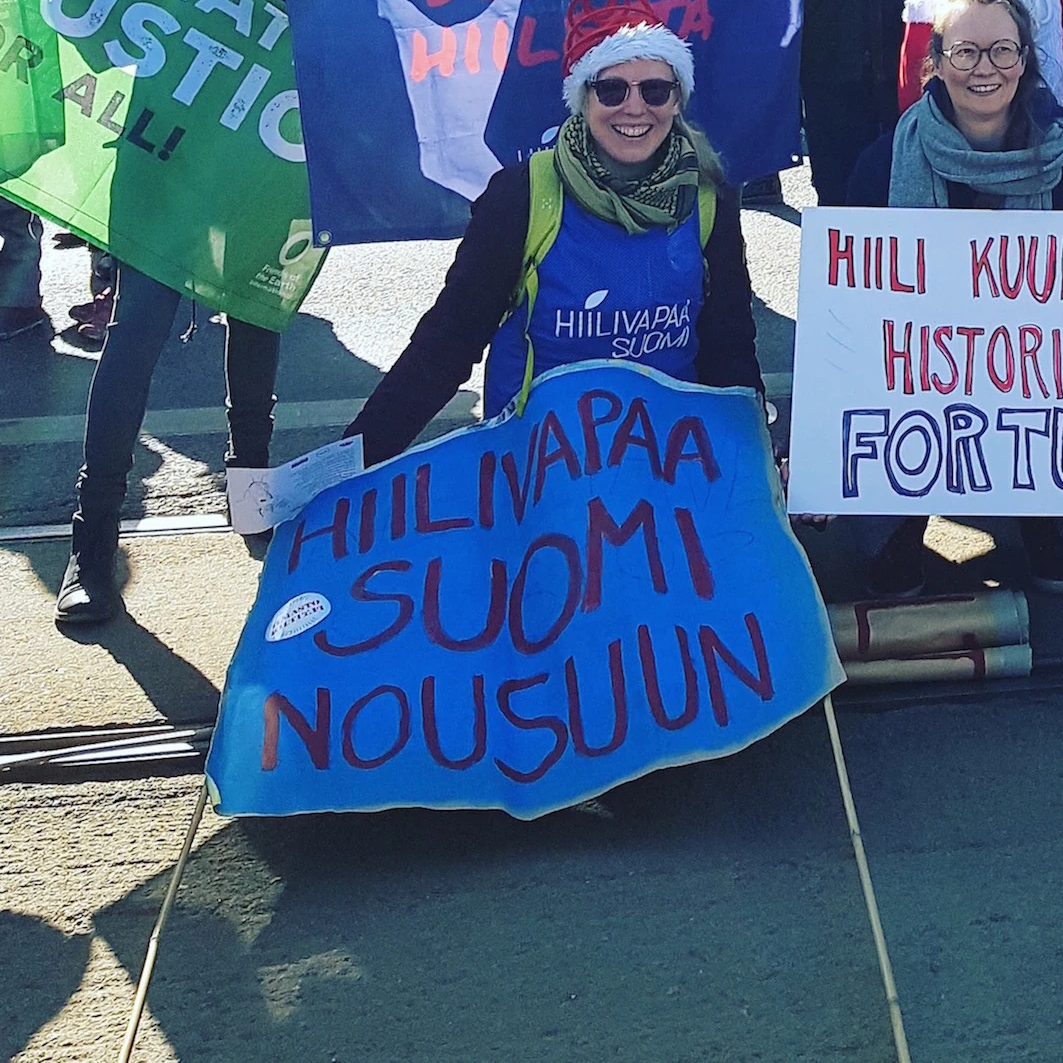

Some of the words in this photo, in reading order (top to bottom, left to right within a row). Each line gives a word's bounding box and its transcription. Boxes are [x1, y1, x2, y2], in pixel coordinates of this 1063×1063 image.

[53, 72, 186, 162] ALL!
[828, 228, 926, 294] HIILI
[555, 298, 690, 338] HIILIVAPAA
[612, 326, 690, 359] SUOMI
[288, 389, 721, 574] HIILIVAPAA
[314, 497, 715, 657] SUOMI
[260, 613, 775, 784] NOUSUUN
